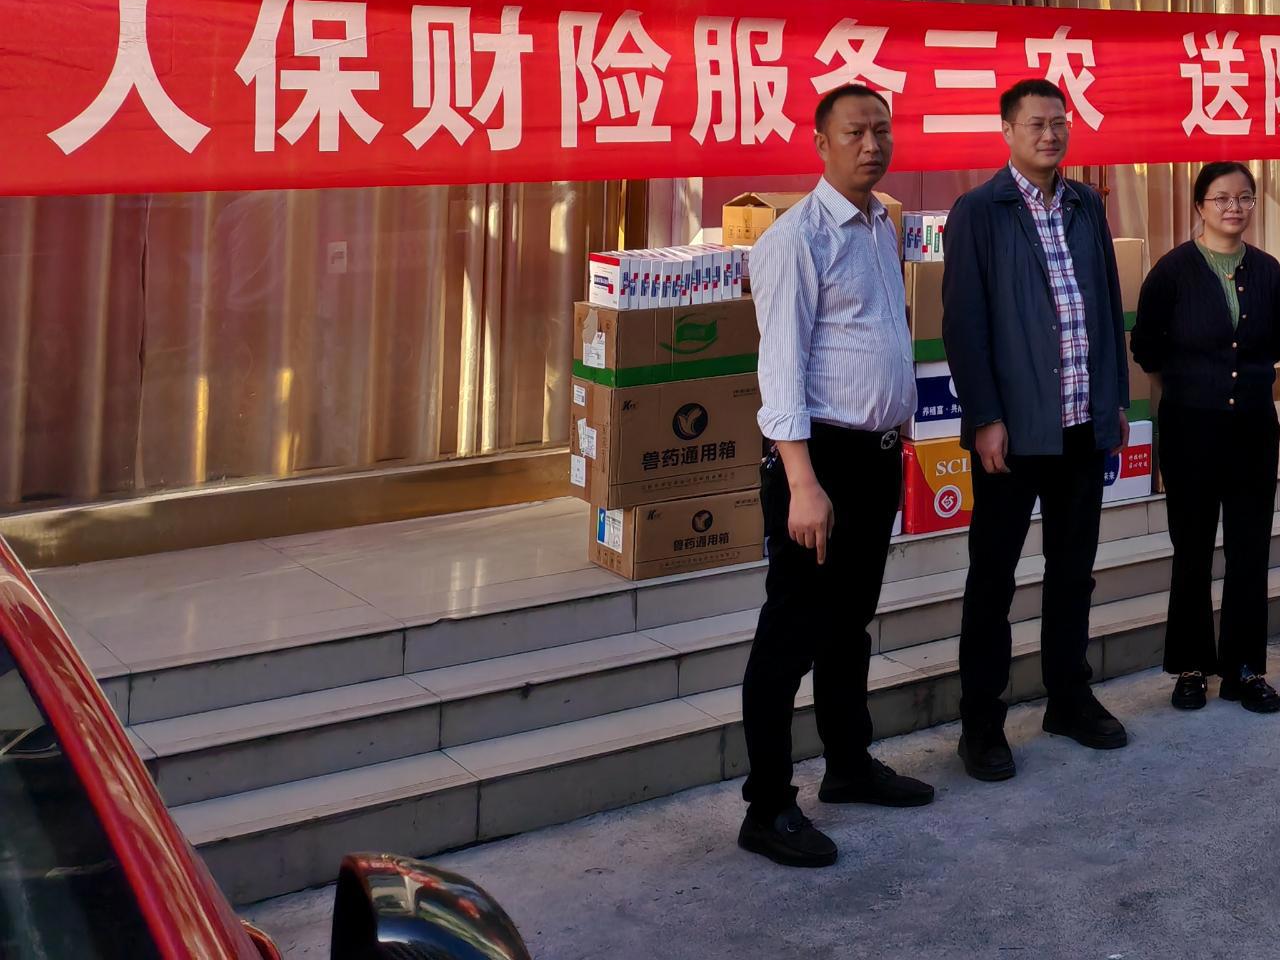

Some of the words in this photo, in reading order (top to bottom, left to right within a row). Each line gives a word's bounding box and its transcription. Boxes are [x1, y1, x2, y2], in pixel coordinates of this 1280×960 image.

[641, 440, 736, 471] 兽药通用箱
[673, 531, 730, 552] 兽药通用箱
